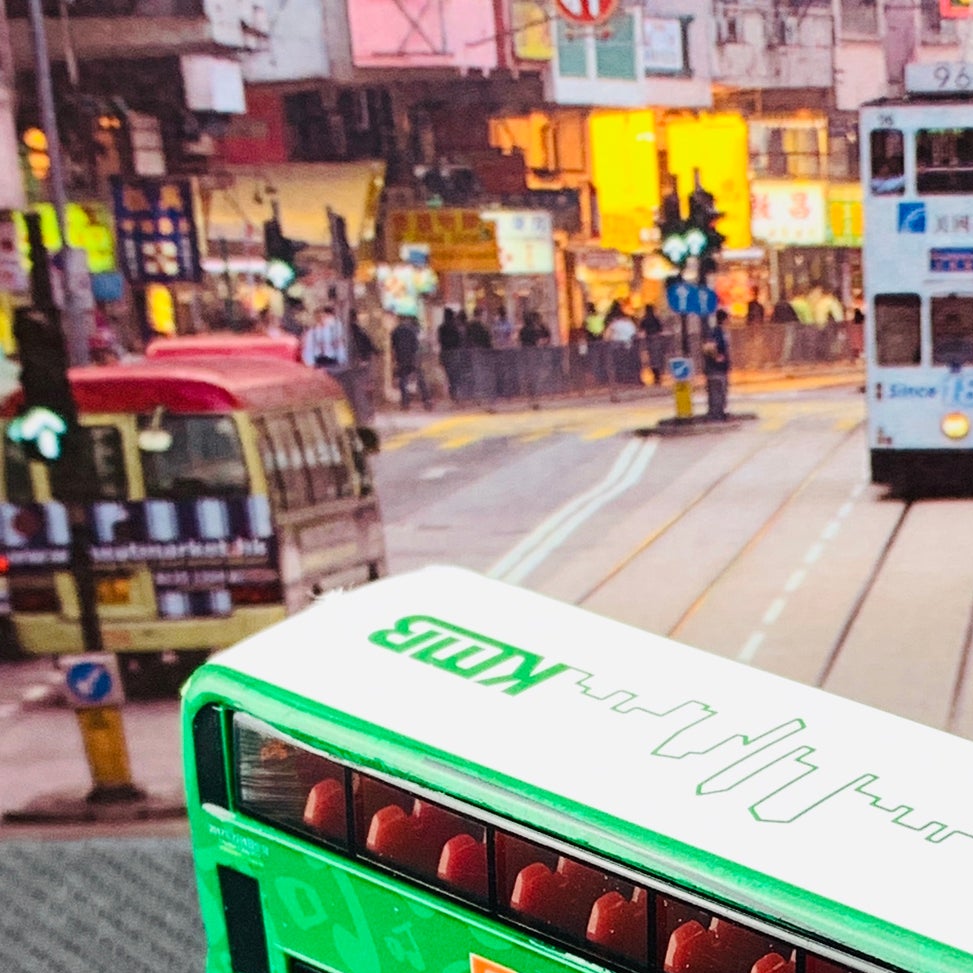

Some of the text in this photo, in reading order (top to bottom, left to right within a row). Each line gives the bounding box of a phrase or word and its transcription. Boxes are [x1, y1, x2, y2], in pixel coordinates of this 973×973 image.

[934, 65, 972, 89] 96
[889, 382, 937, 399] Since
[367, 614, 571, 697] KMB
